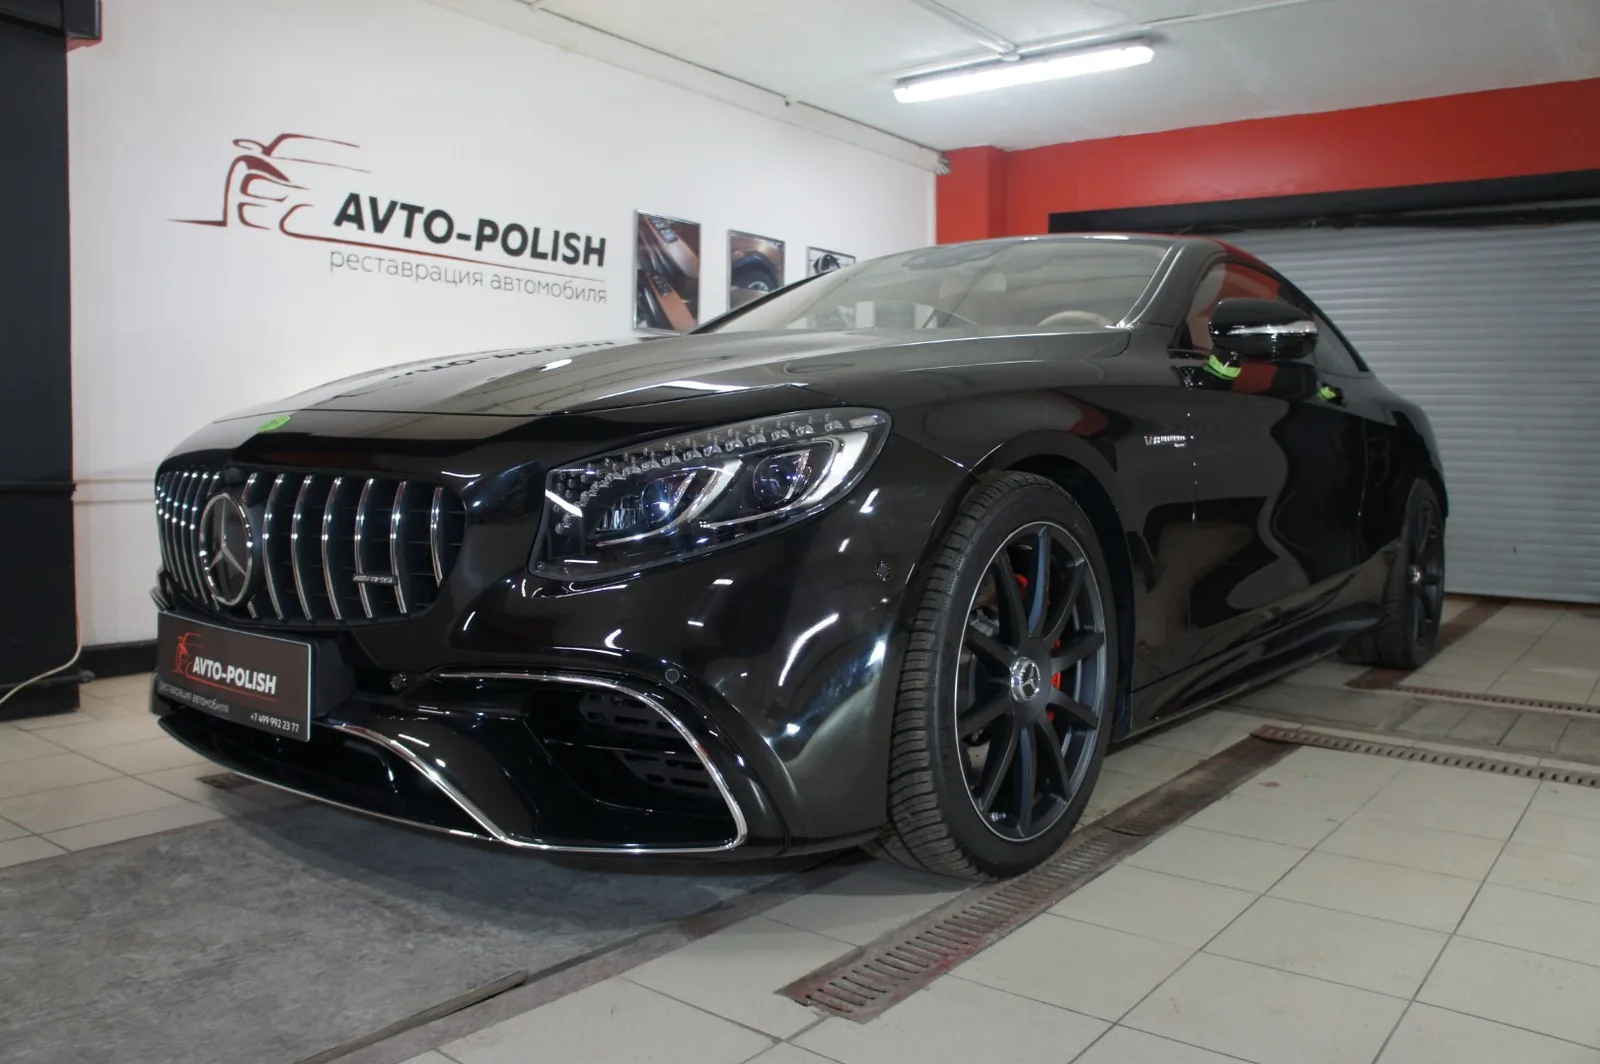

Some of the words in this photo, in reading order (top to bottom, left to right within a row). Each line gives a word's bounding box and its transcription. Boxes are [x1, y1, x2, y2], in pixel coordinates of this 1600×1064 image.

[334, 193, 606, 266] AVTO-POLISH
[329, 251, 483, 286] реставрация
[490, 272, 606, 303] автомобиля
[193, 656, 276, 694] AVTO-POLISH
[250, 712, 258, 722] +7
[258, 714, 270, 725] 499
[270, 717, 282, 729] 992
[282, 720, 291, 731] 23
[291, 722, 300, 733] 77
